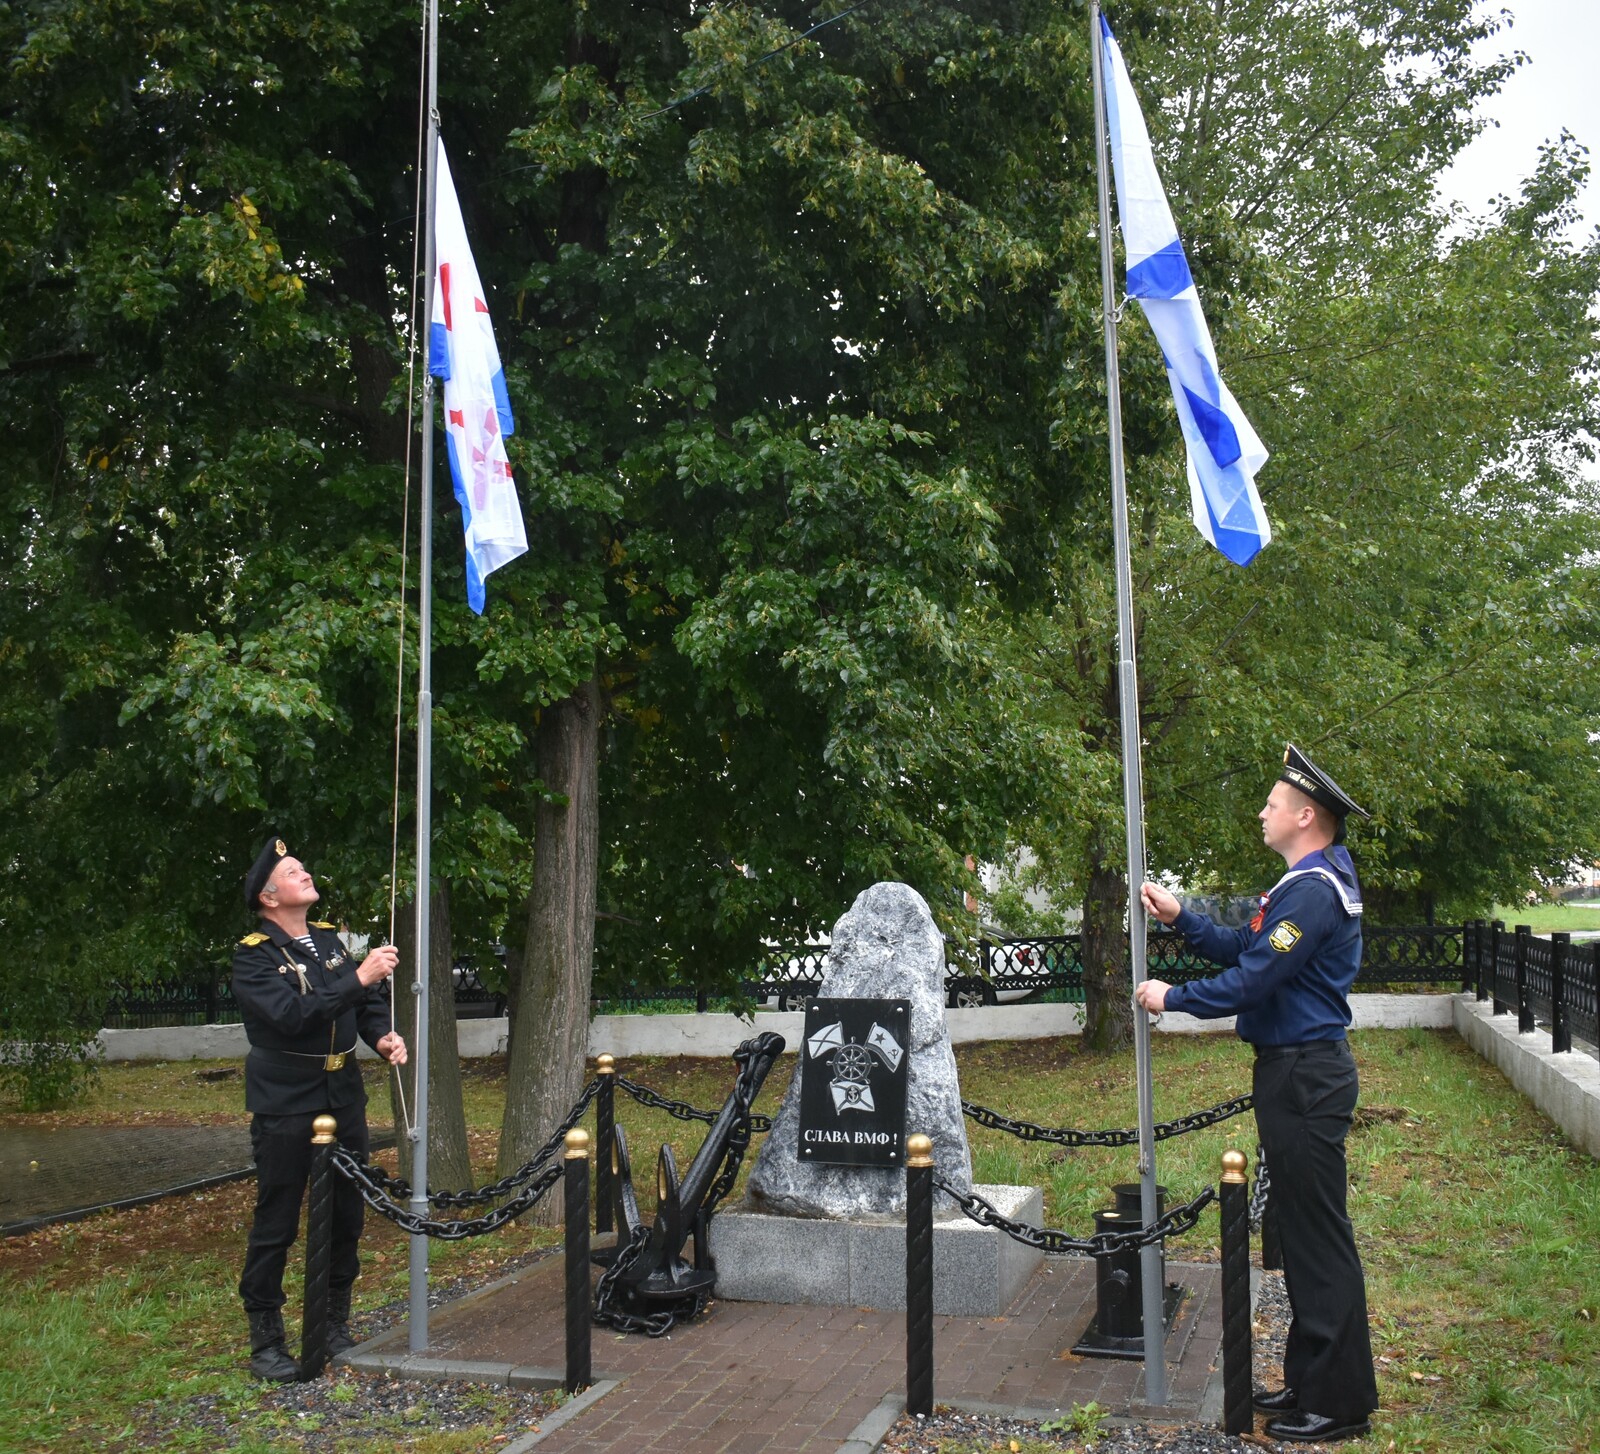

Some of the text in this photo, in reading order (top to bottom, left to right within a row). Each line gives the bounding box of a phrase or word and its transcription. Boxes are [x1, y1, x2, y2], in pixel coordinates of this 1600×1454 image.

[1300, 778, 1317, 792] ФЛОТ
[1280, 922, 1300, 938] РОССИЯ
[804, 1129, 850, 1143] СЛАВА
[854, 1131, 890, 1145] ВМФ
